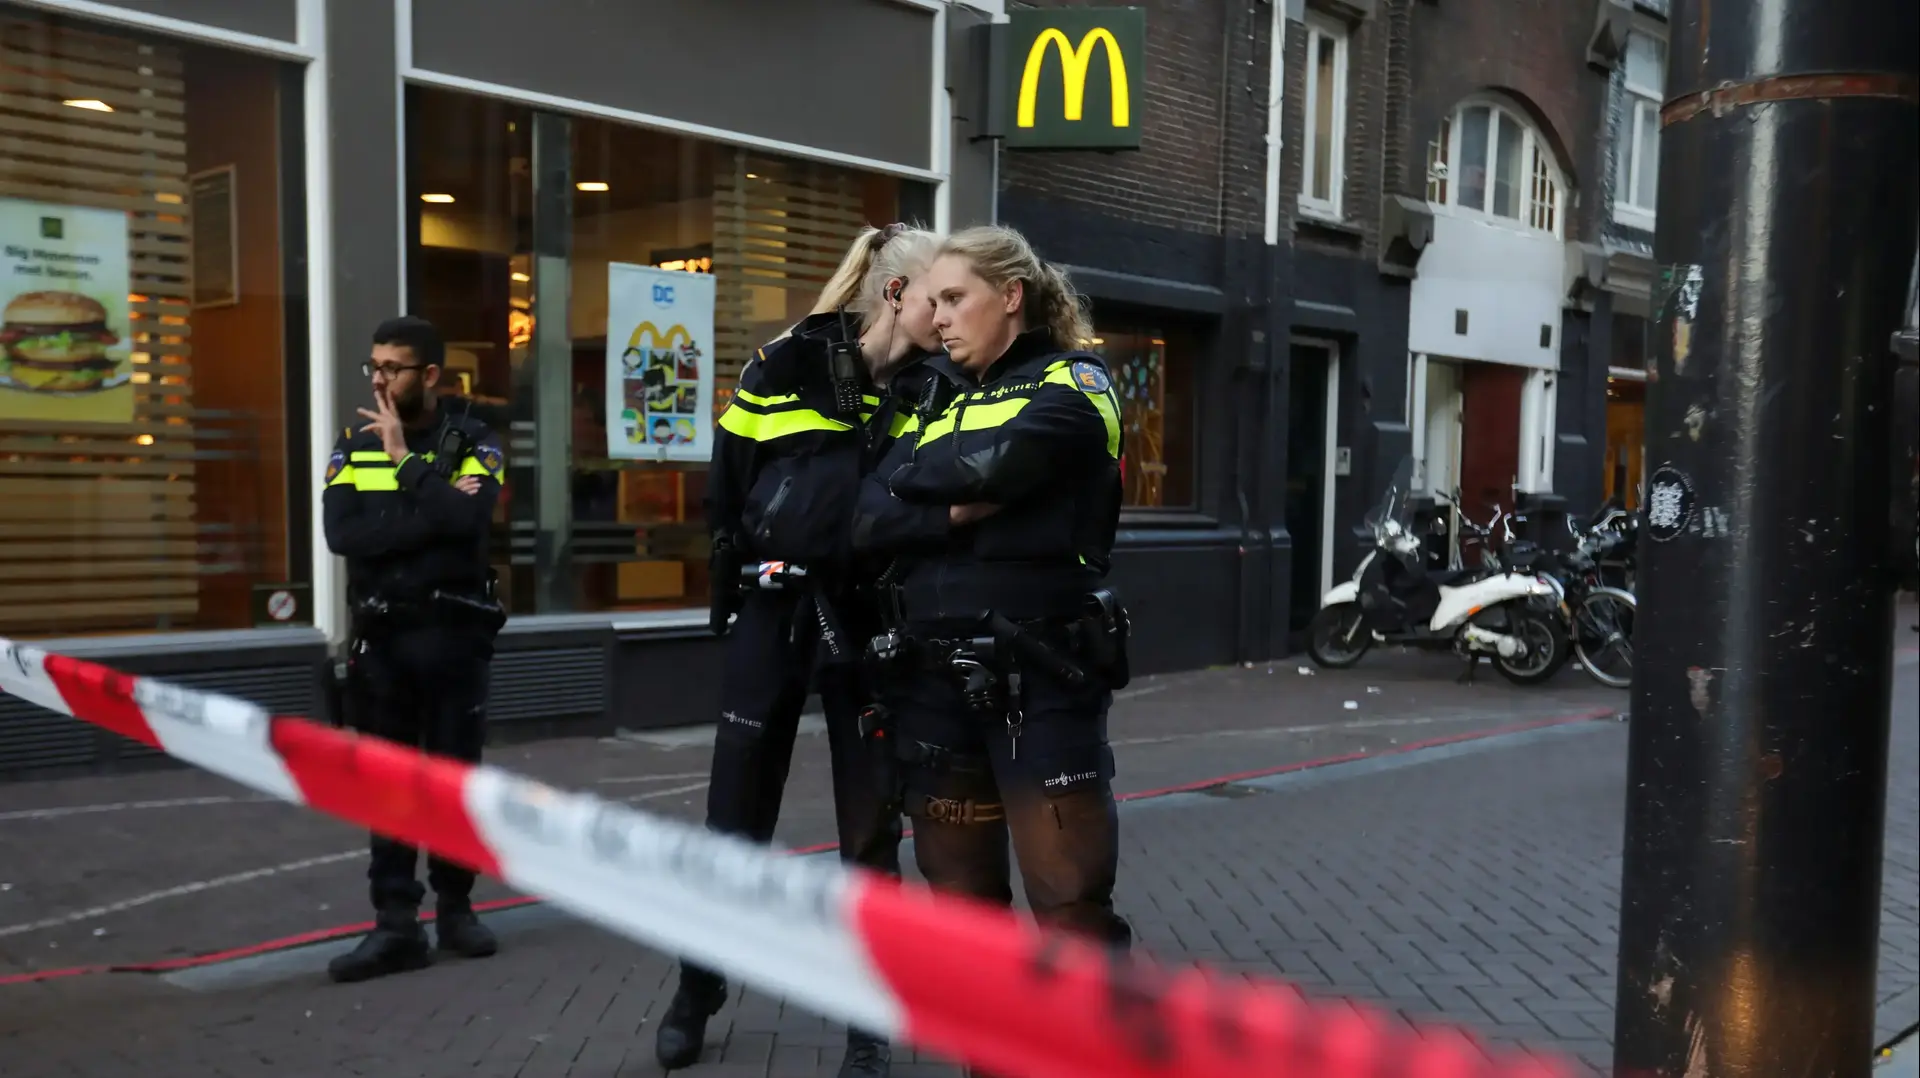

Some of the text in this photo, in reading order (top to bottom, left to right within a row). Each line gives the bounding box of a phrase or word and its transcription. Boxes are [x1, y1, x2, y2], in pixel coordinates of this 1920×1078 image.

[1017, 26, 1130, 128] M
[652, 285, 674, 304] DC
[990, 383, 1032, 399] POLITIE
[1054, 772, 1090, 786] POLITIE
